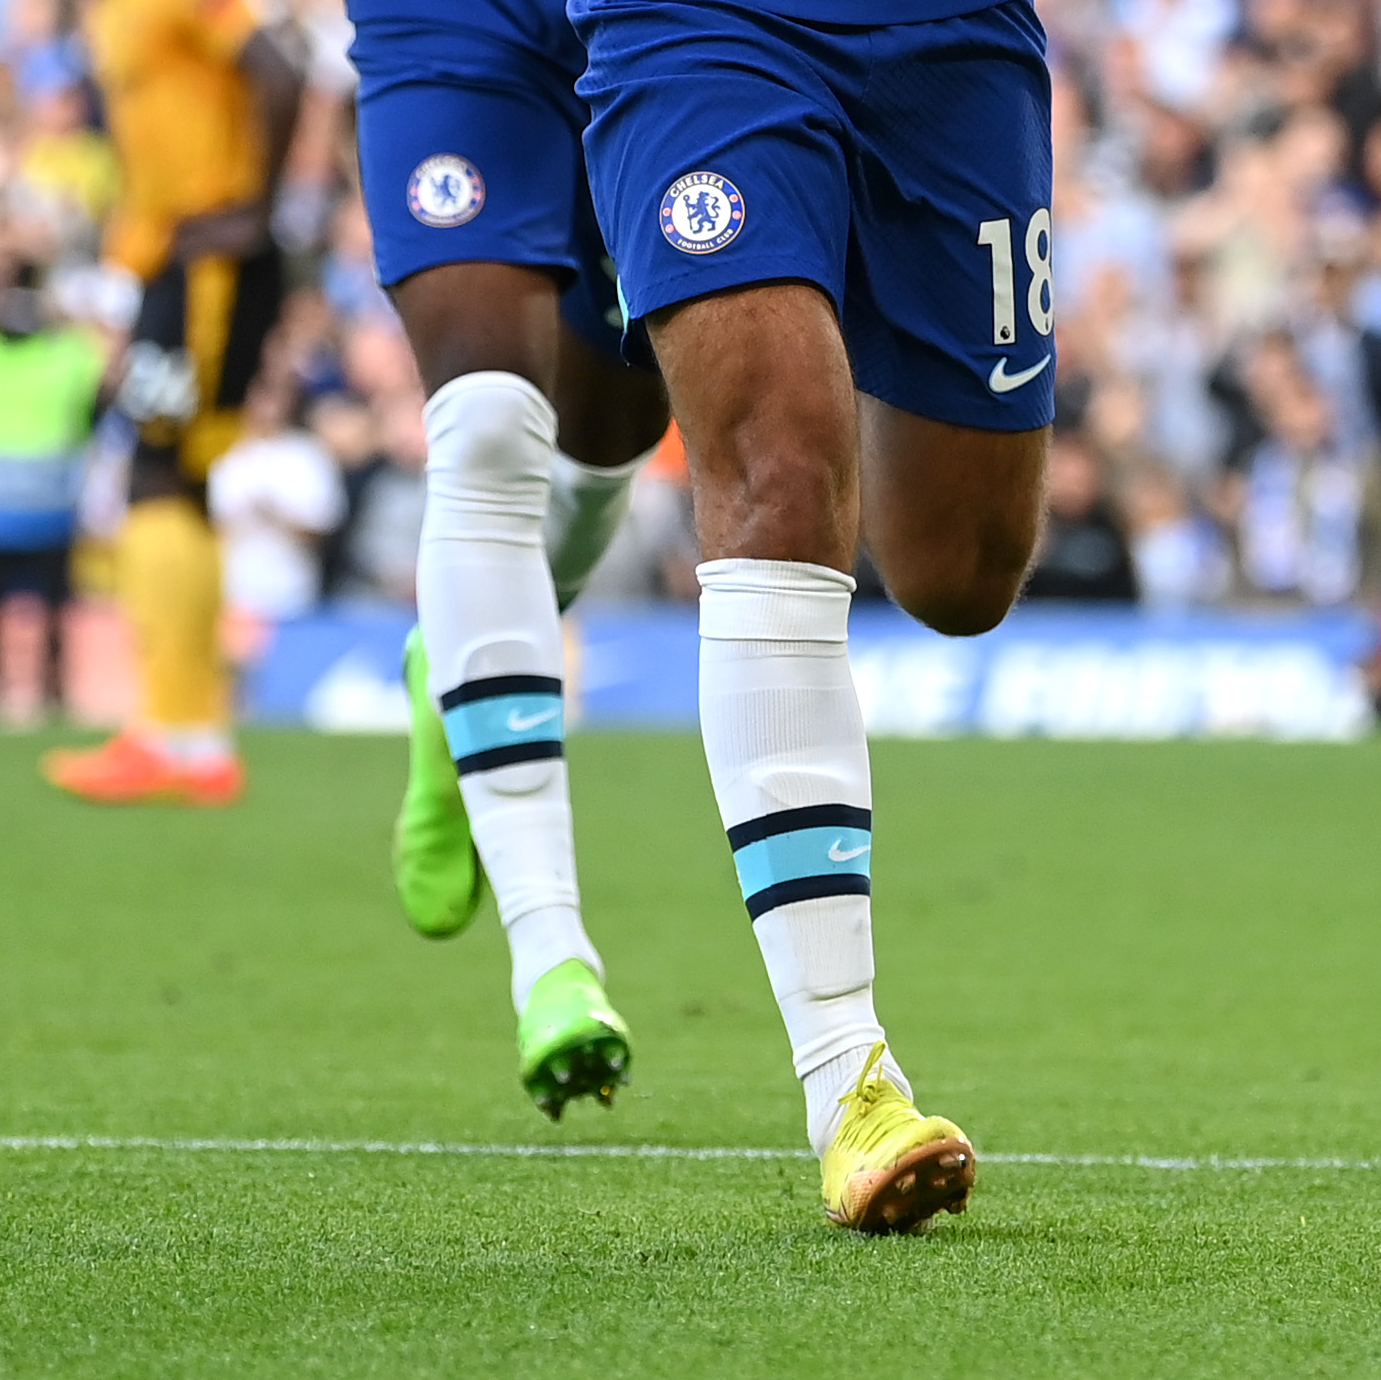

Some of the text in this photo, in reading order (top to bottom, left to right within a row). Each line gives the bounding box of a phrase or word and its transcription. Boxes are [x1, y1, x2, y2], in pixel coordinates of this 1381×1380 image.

[670, 174, 724, 198] CHELSEA
[677, 238, 715, 250] FOOTBALL
[977, 207, 1054, 345] 18
